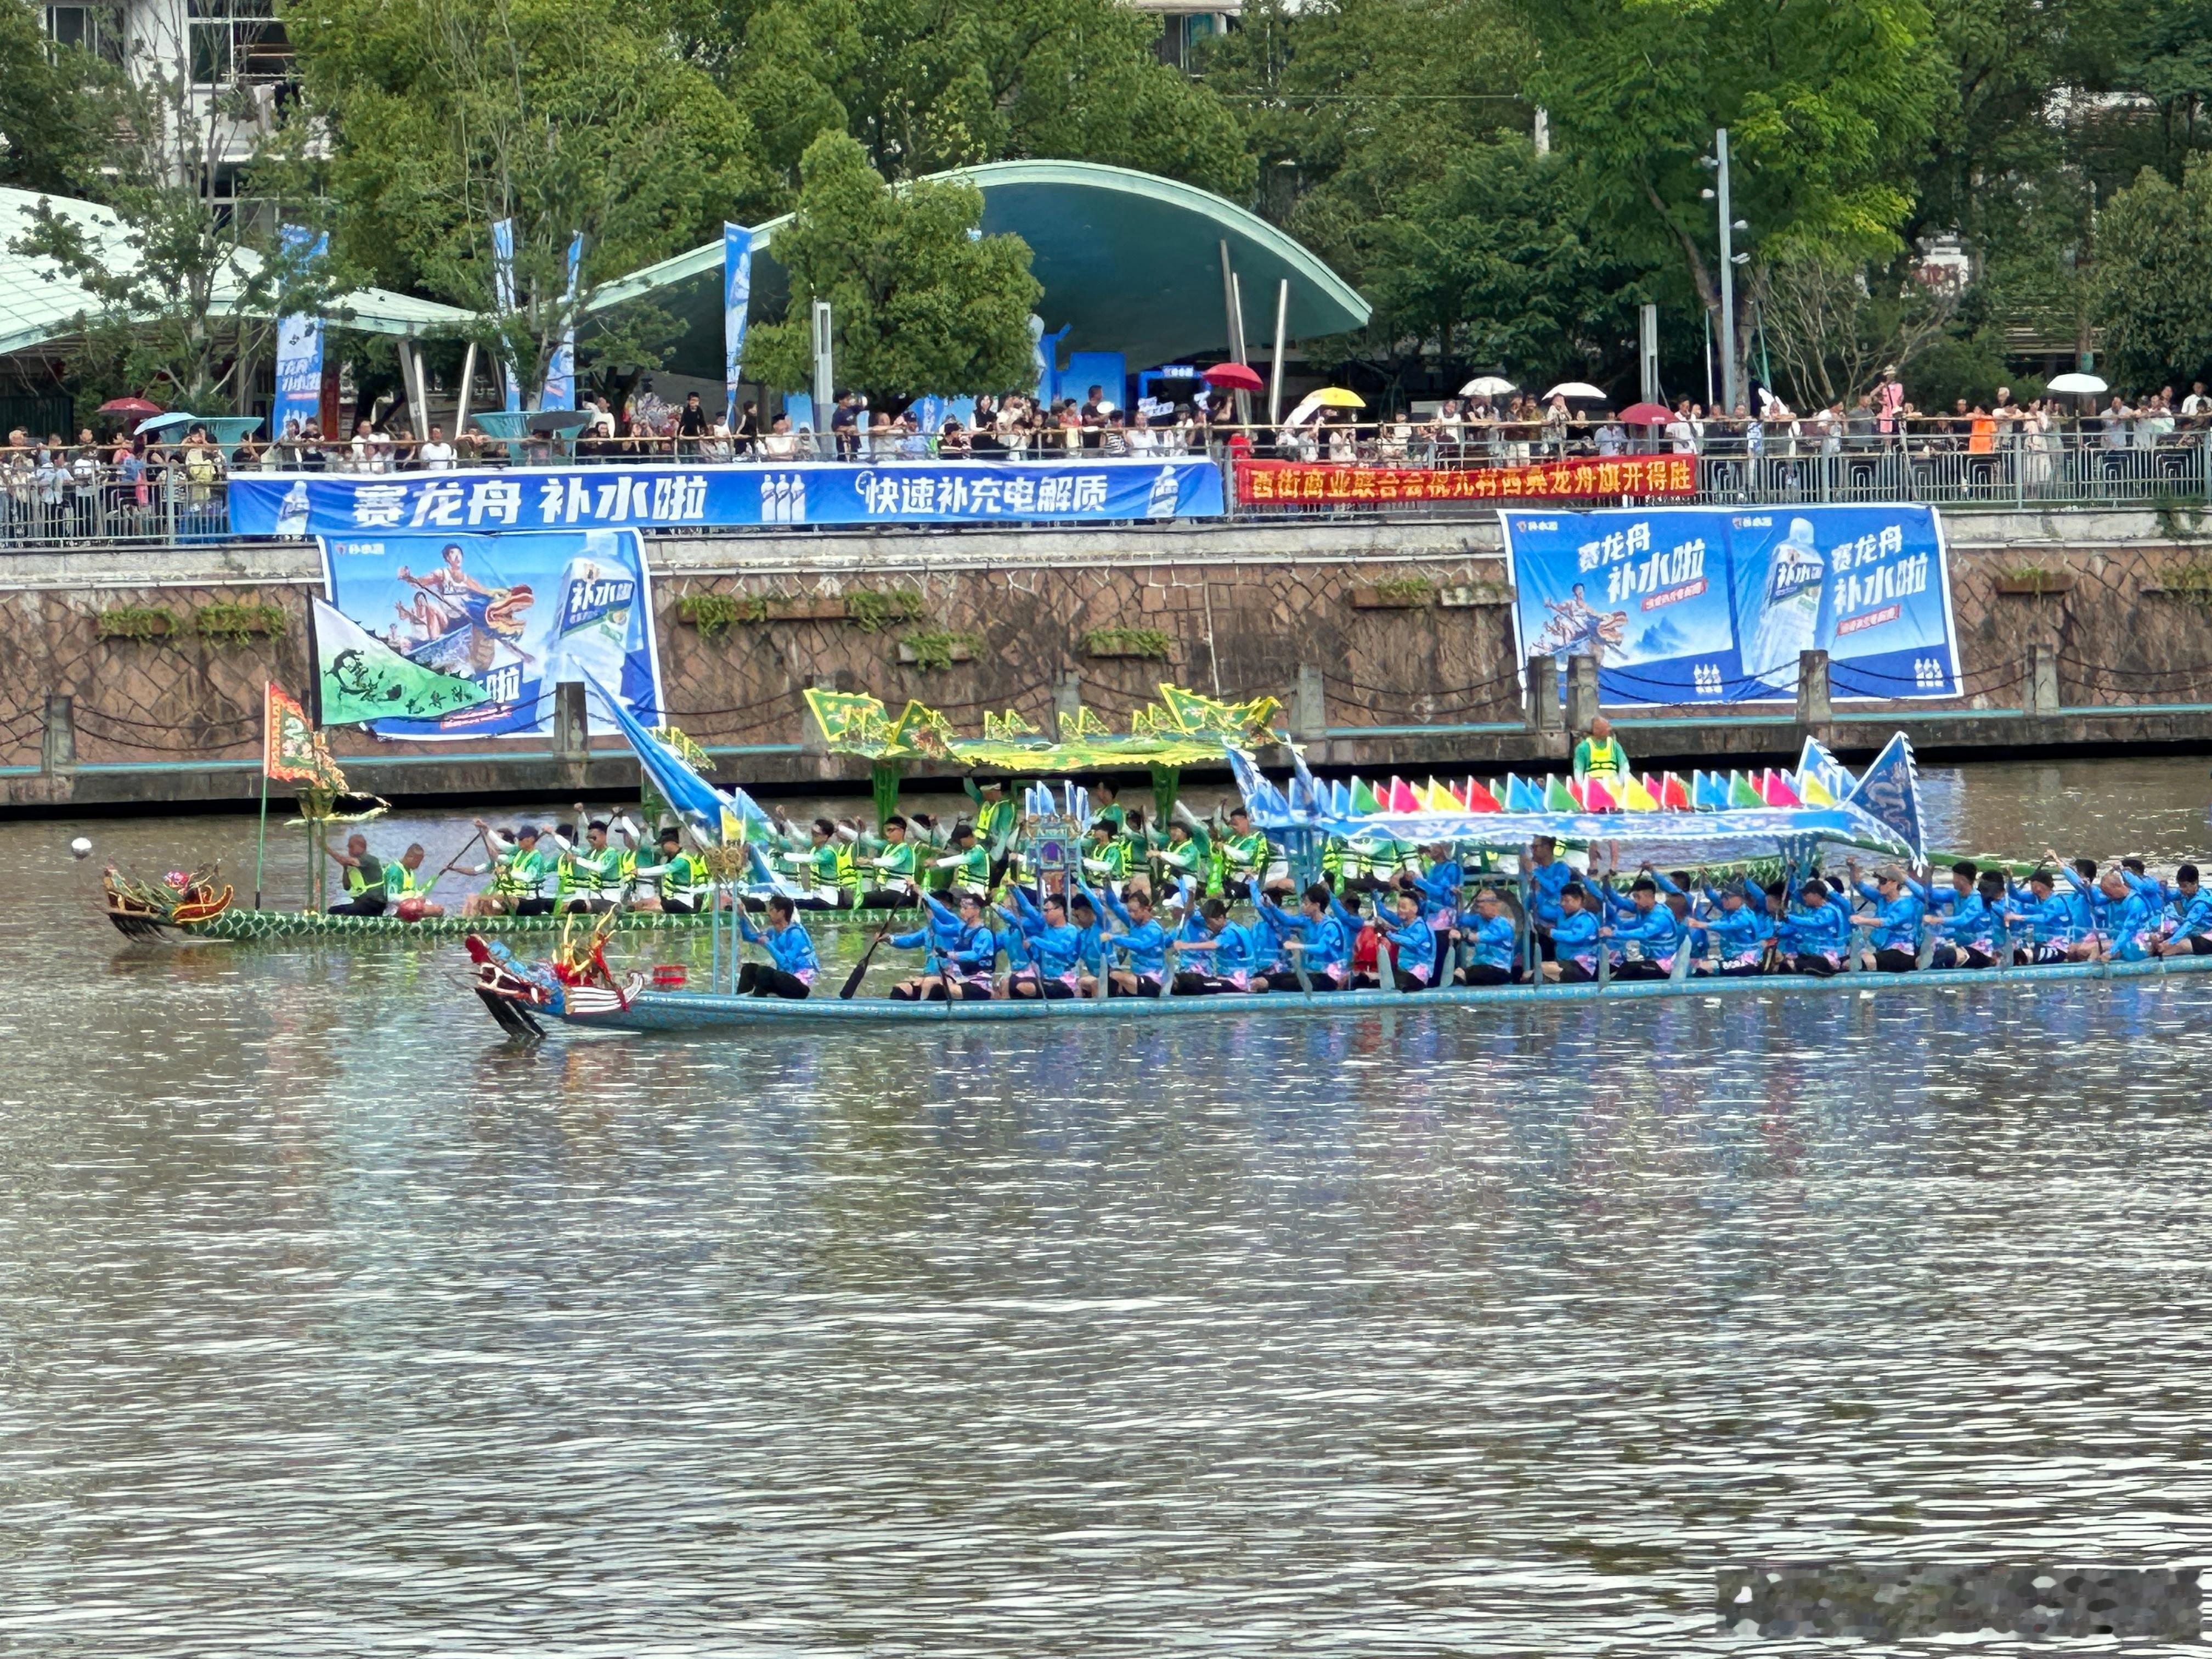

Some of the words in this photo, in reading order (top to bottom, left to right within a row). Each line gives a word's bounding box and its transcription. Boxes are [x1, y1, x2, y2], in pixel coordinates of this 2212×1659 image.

[352, 481, 522, 527] 赛龙舟
[539, 476, 704, 523] 补水啦
[866, 474, 1108, 514] 快速补充电解质
[1578, 521, 1651, 573] 赛龙舟
[1607, 538, 1706, 603] 补水啦
[1831, 524, 1903, 573] 赛龙舟
[1834, 552, 1928, 616] 补水啦
